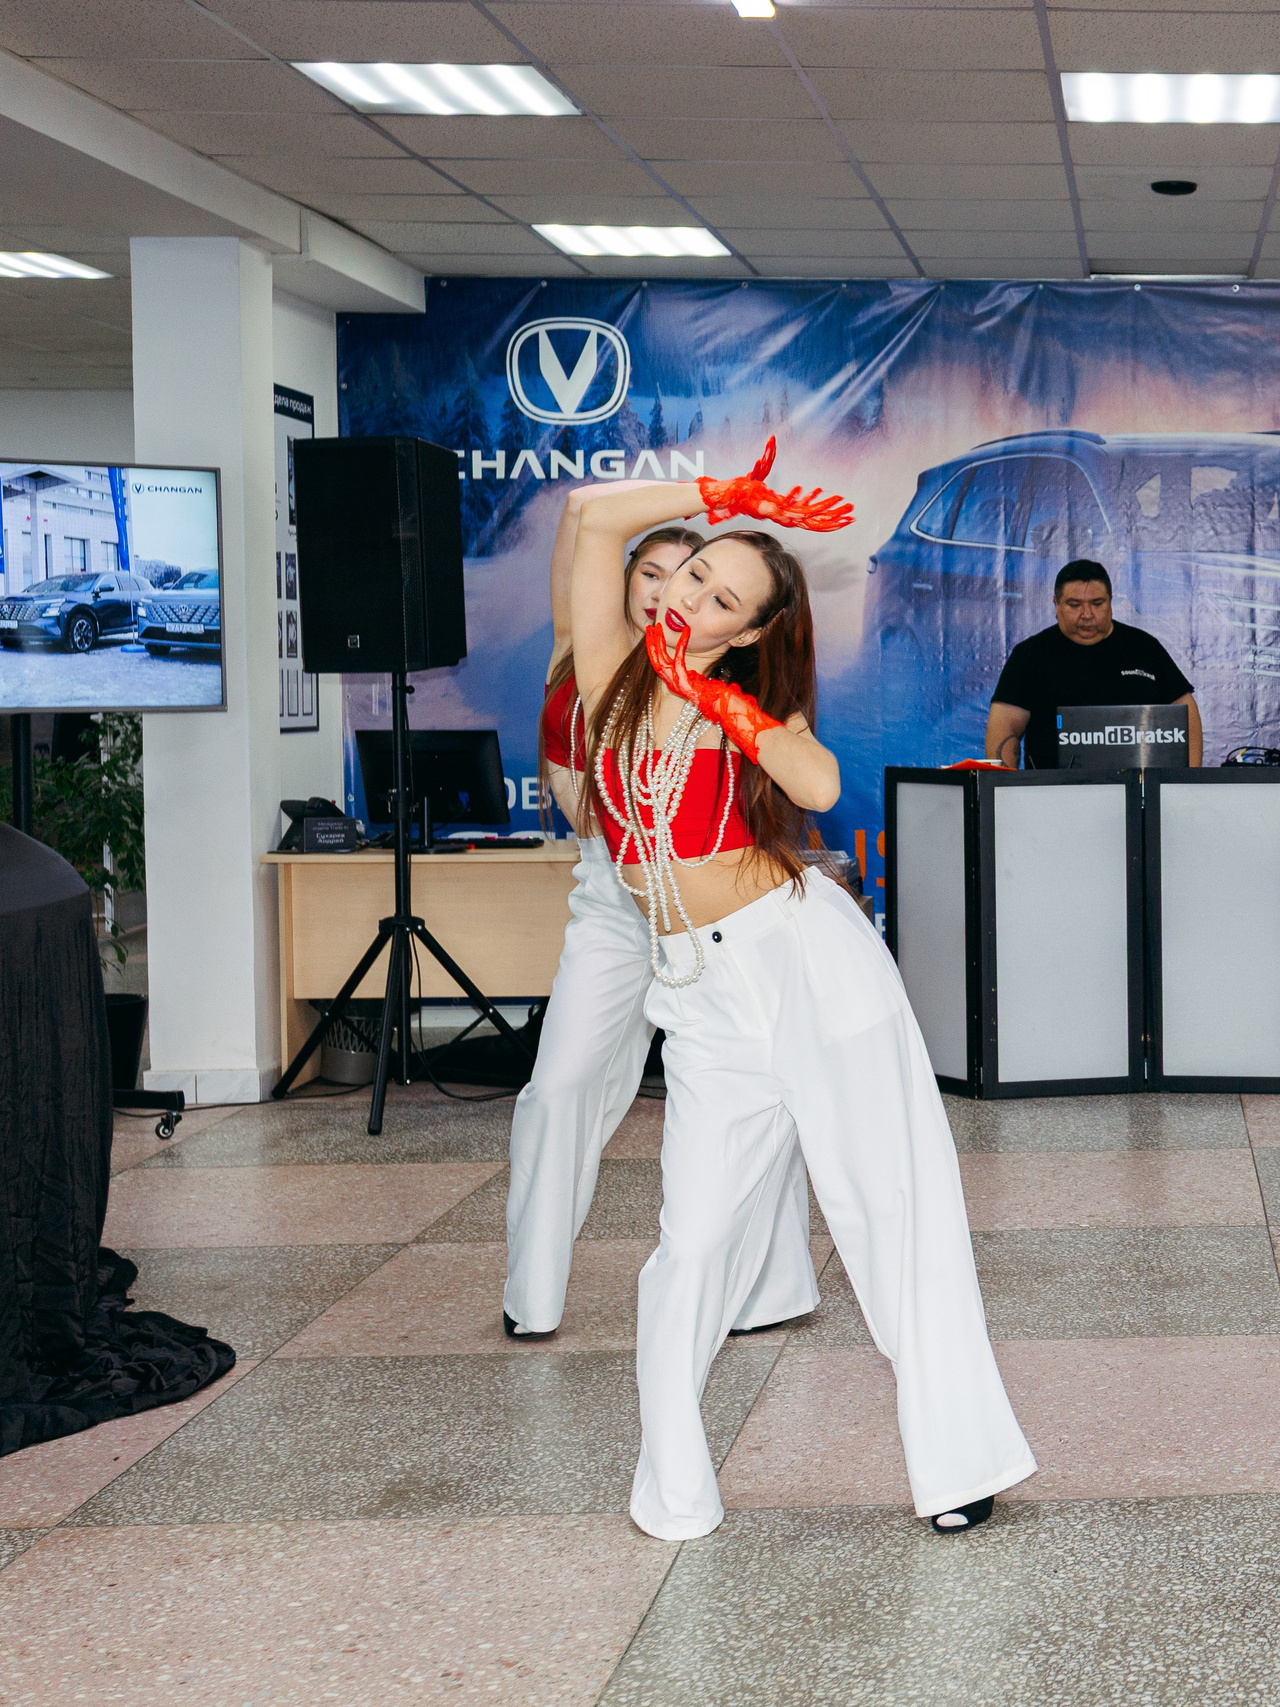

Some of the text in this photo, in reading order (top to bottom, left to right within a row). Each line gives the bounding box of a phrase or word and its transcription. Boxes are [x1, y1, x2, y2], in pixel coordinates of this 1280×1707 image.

[274, 394, 288, 408] дела
[147, 485, 203, 494] CHANGAN
[1058, 726, 1186, 745] soundBratsk
